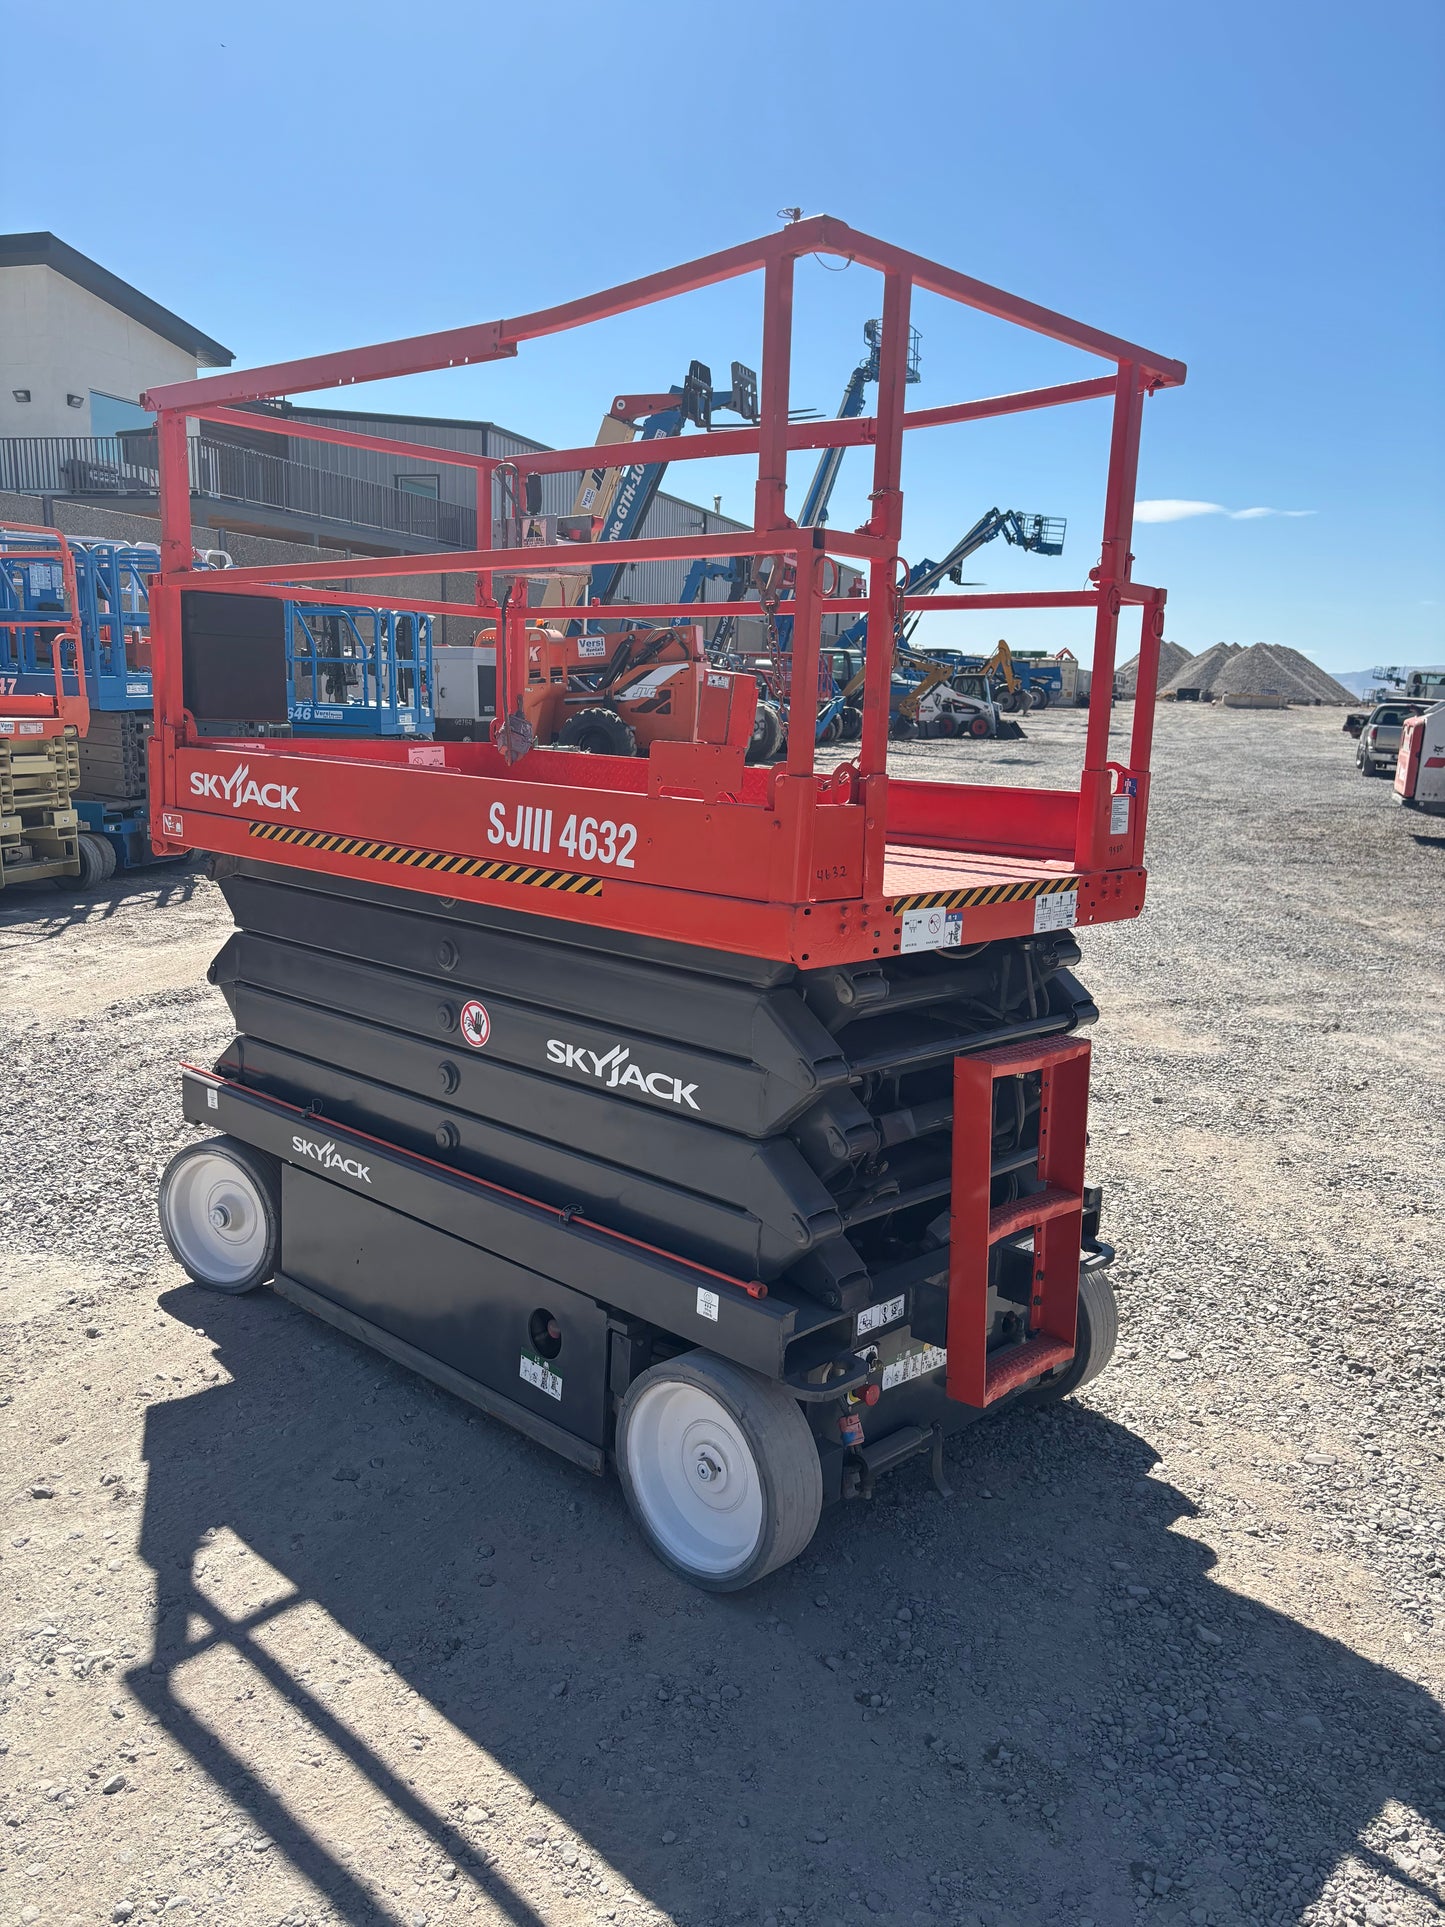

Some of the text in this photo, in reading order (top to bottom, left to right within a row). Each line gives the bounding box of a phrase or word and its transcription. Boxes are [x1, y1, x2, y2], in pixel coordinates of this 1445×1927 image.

[617, 464, 645, 519] GTH-10
[579, 638, 604, 647] Versi
[190, 762, 302, 812] SKYJACK
[487, 801, 638, 869] SJIII 4632
[816, 865, 847, 881] 4632
[546, 1039, 701, 1111] SKYJACK
[292, 1135, 372, 1184] SKYJACK
